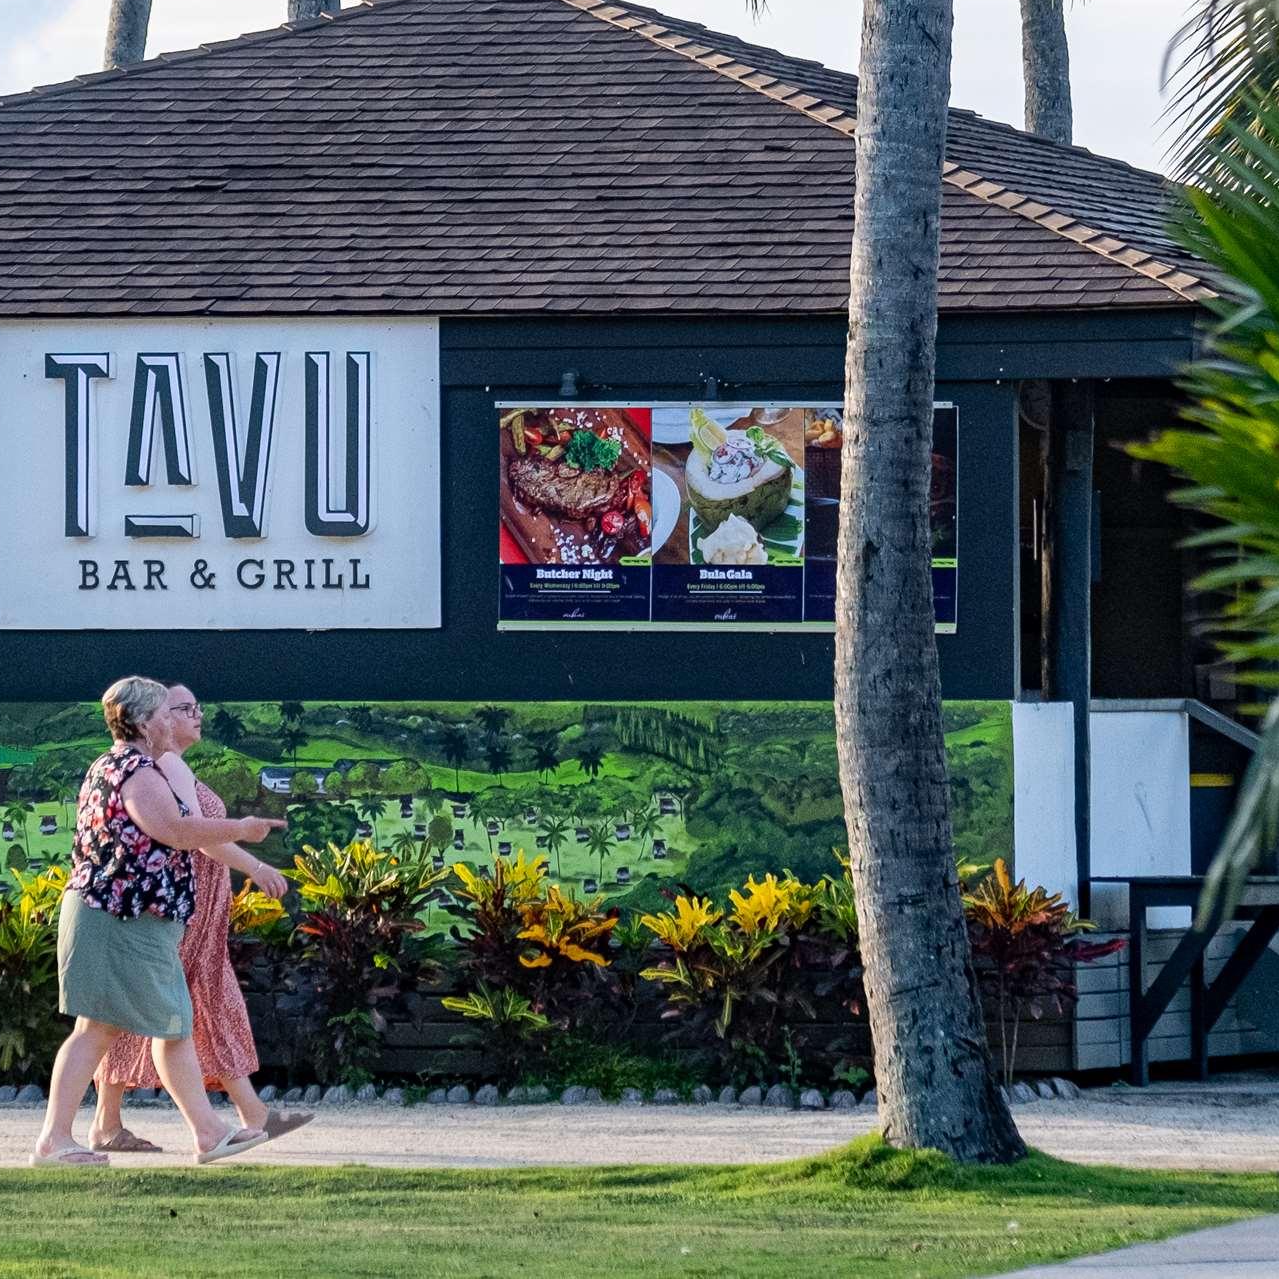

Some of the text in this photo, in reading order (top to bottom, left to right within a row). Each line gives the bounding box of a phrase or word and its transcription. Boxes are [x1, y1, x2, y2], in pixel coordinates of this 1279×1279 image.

[44, 350, 377, 539] TAVU
[78, 558, 370, 590] BAR & GRILL
[536, 568, 614, 581] Butcher Night
[699, 569, 753, 580] Bula Gala
